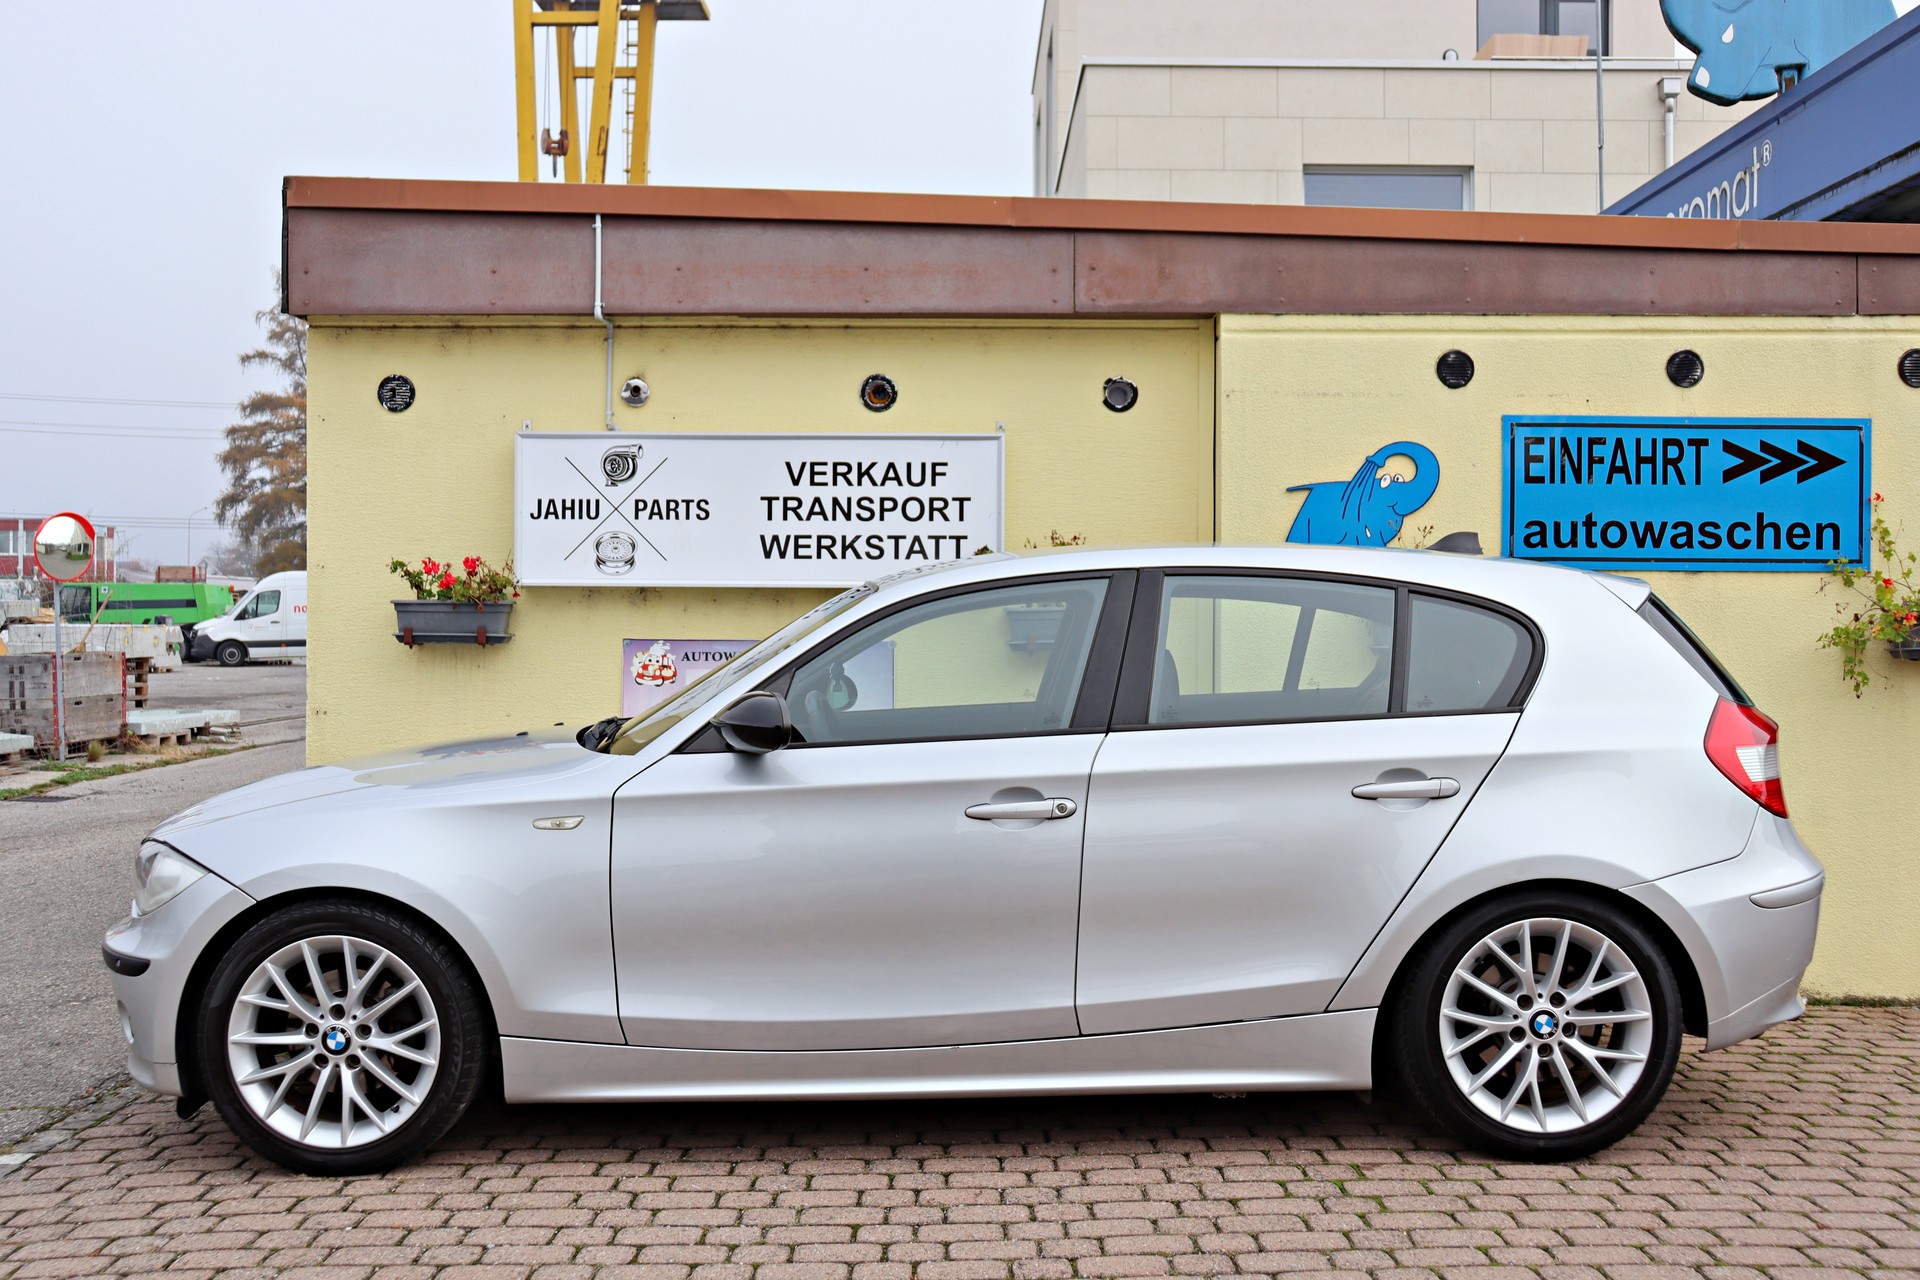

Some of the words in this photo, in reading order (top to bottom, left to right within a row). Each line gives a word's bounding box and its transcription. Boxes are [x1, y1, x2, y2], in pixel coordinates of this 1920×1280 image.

[1523, 436, 1710, 486] EINFAHRT
[785, 461, 949, 488] VERKAUF
[530, 498, 600, 520] JAHIU
[634, 499, 710, 520] PARTS
[760, 496, 972, 522] TRANSPORT
[1523, 511, 1841, 551] autowaschen
[760, 534, 968, 560] WERKSTATT
[681, 651, 737, 662] AUTOW
